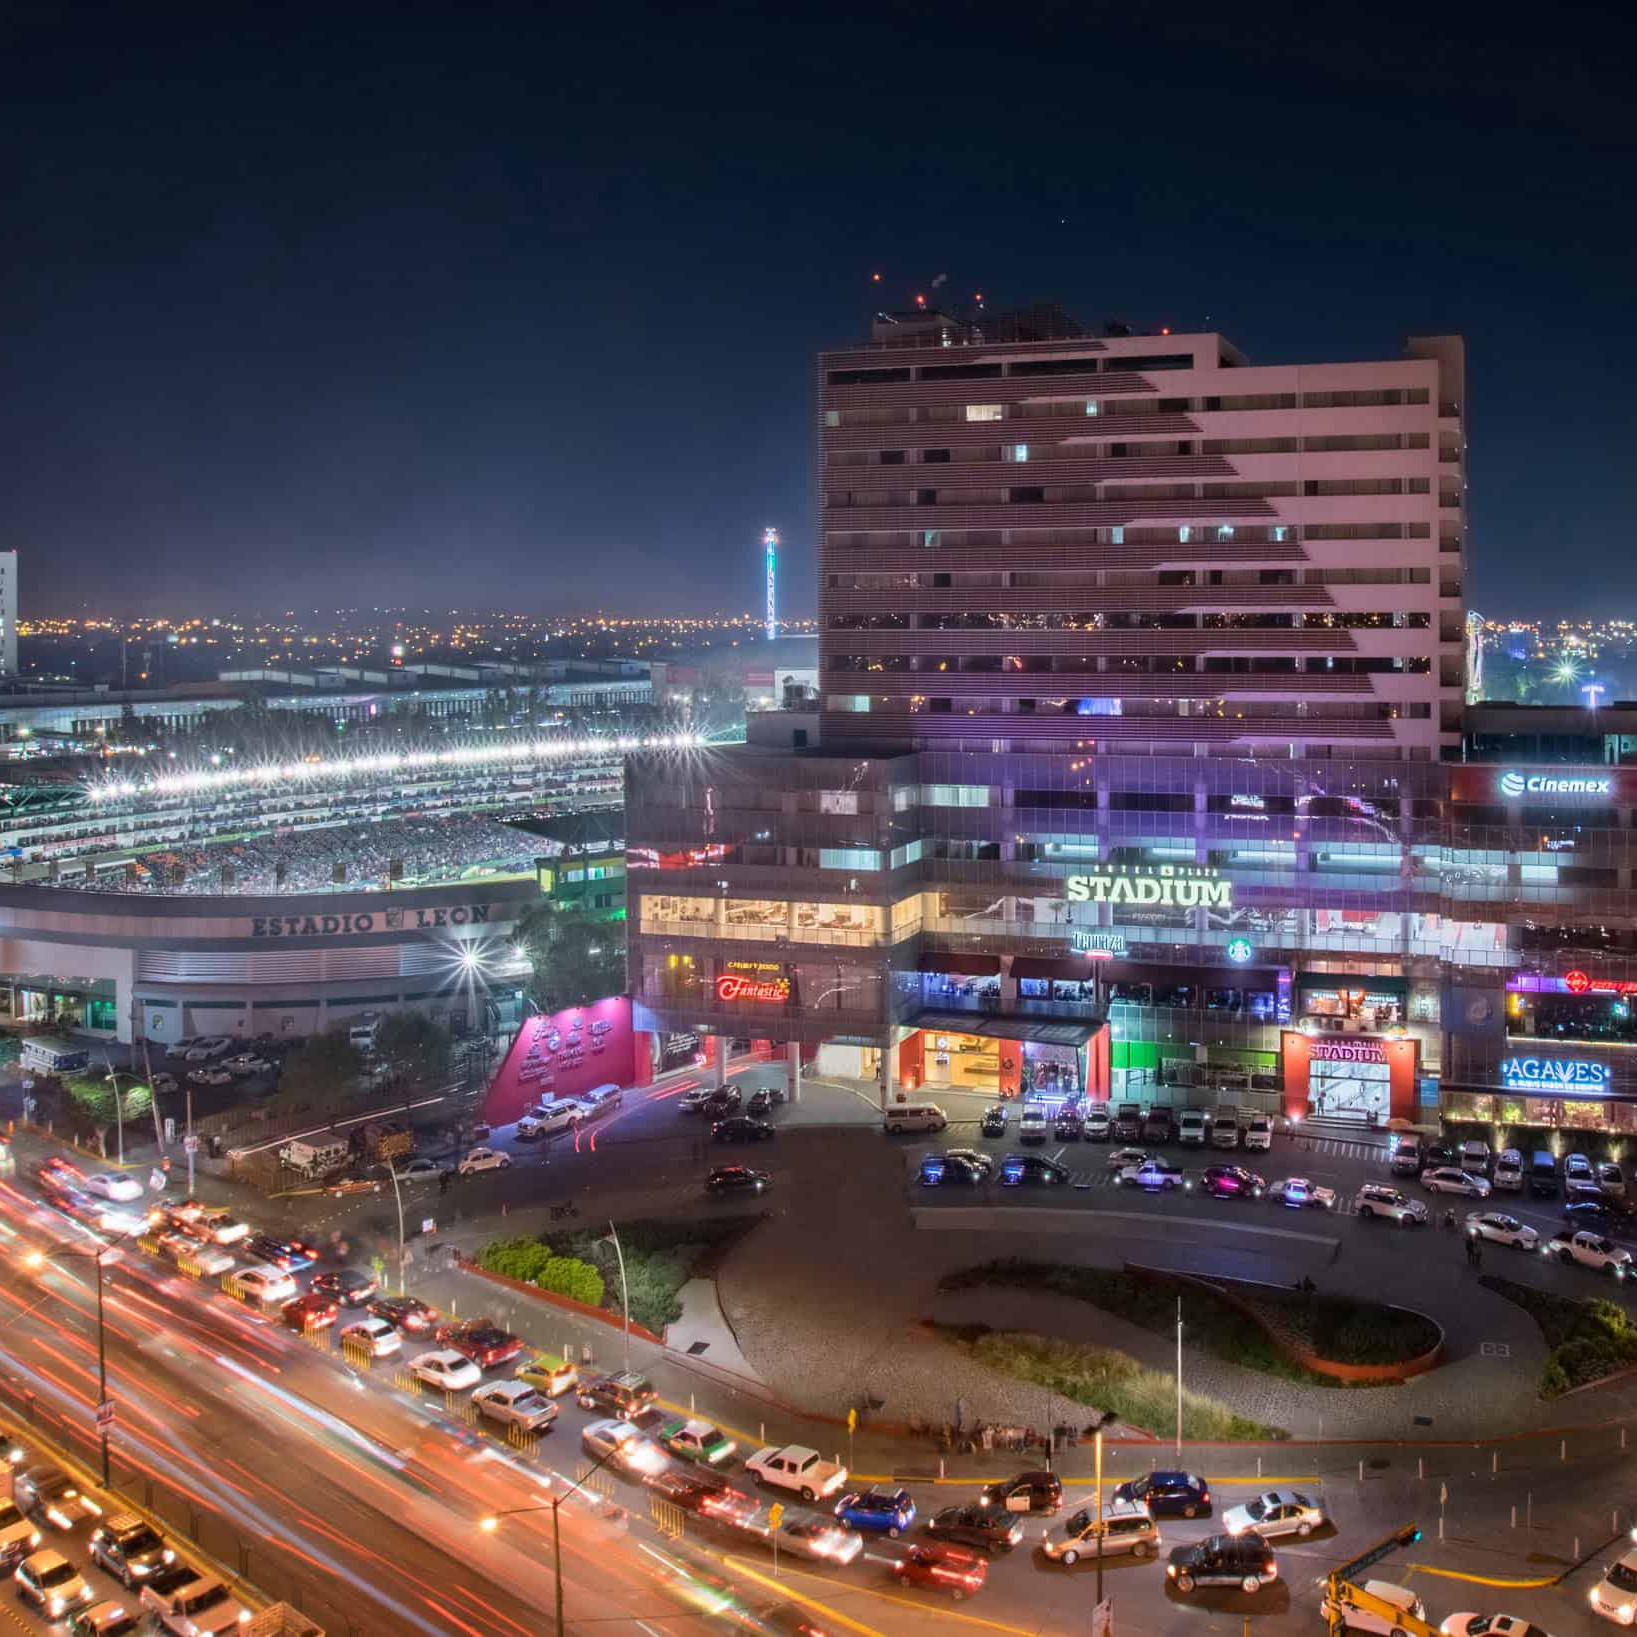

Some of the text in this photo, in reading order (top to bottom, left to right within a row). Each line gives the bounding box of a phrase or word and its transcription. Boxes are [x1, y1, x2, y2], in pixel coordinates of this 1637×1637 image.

[1527, 777, 1609, 793] Cinemex
[1068, 875, 1232, 907] STADIUM
[252, 904, 490, 937] ESTADIO LEON
[717, 975, 784, 1000] Fantastic
[1310, 1045, 1389, 1063] STADIUM
[1506, 1058, 1603, 1082] AGAVES
